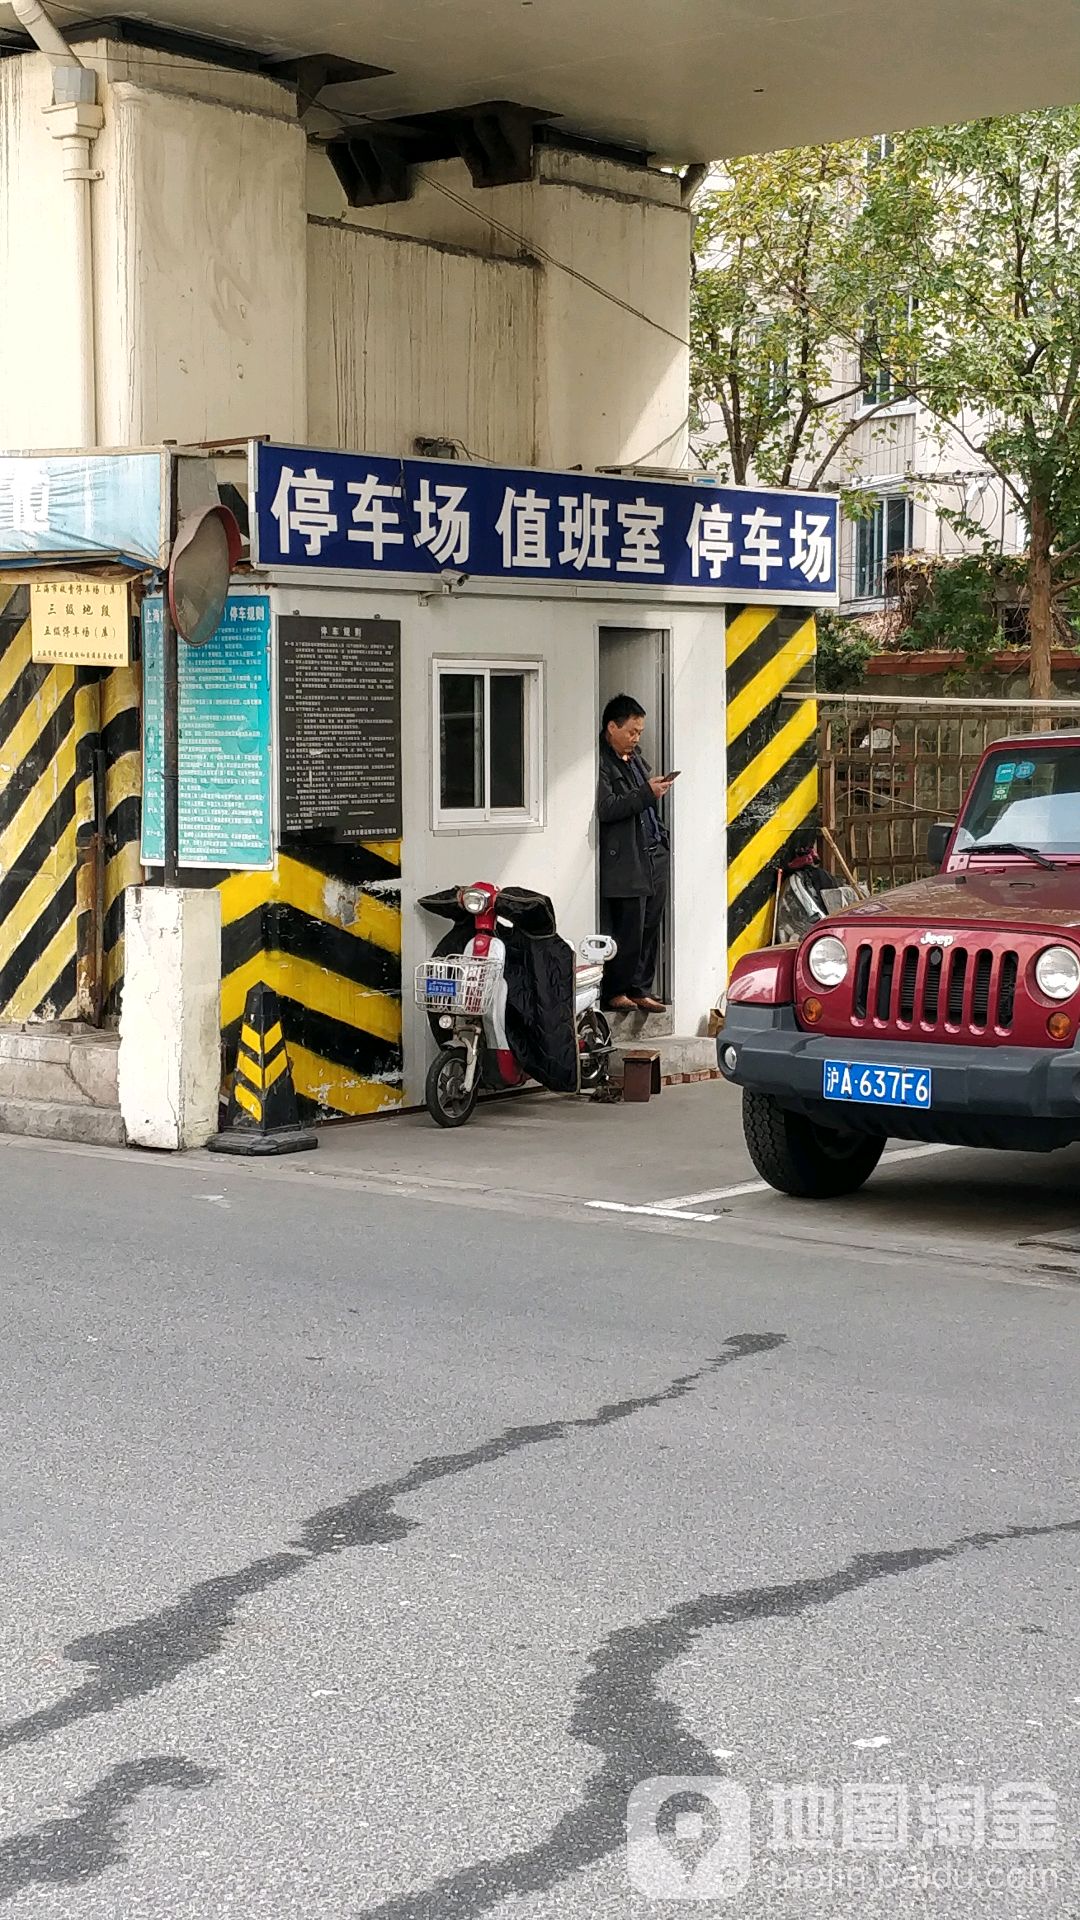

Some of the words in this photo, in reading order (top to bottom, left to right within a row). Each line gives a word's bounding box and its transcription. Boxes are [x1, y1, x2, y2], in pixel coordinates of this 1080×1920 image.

[270, 464, 470, 565] 停车场
[495, 486, 665, 574] 值班室
[685, 502, 832, 583] 停车场
[920, 931, 954, 947] Jeep
